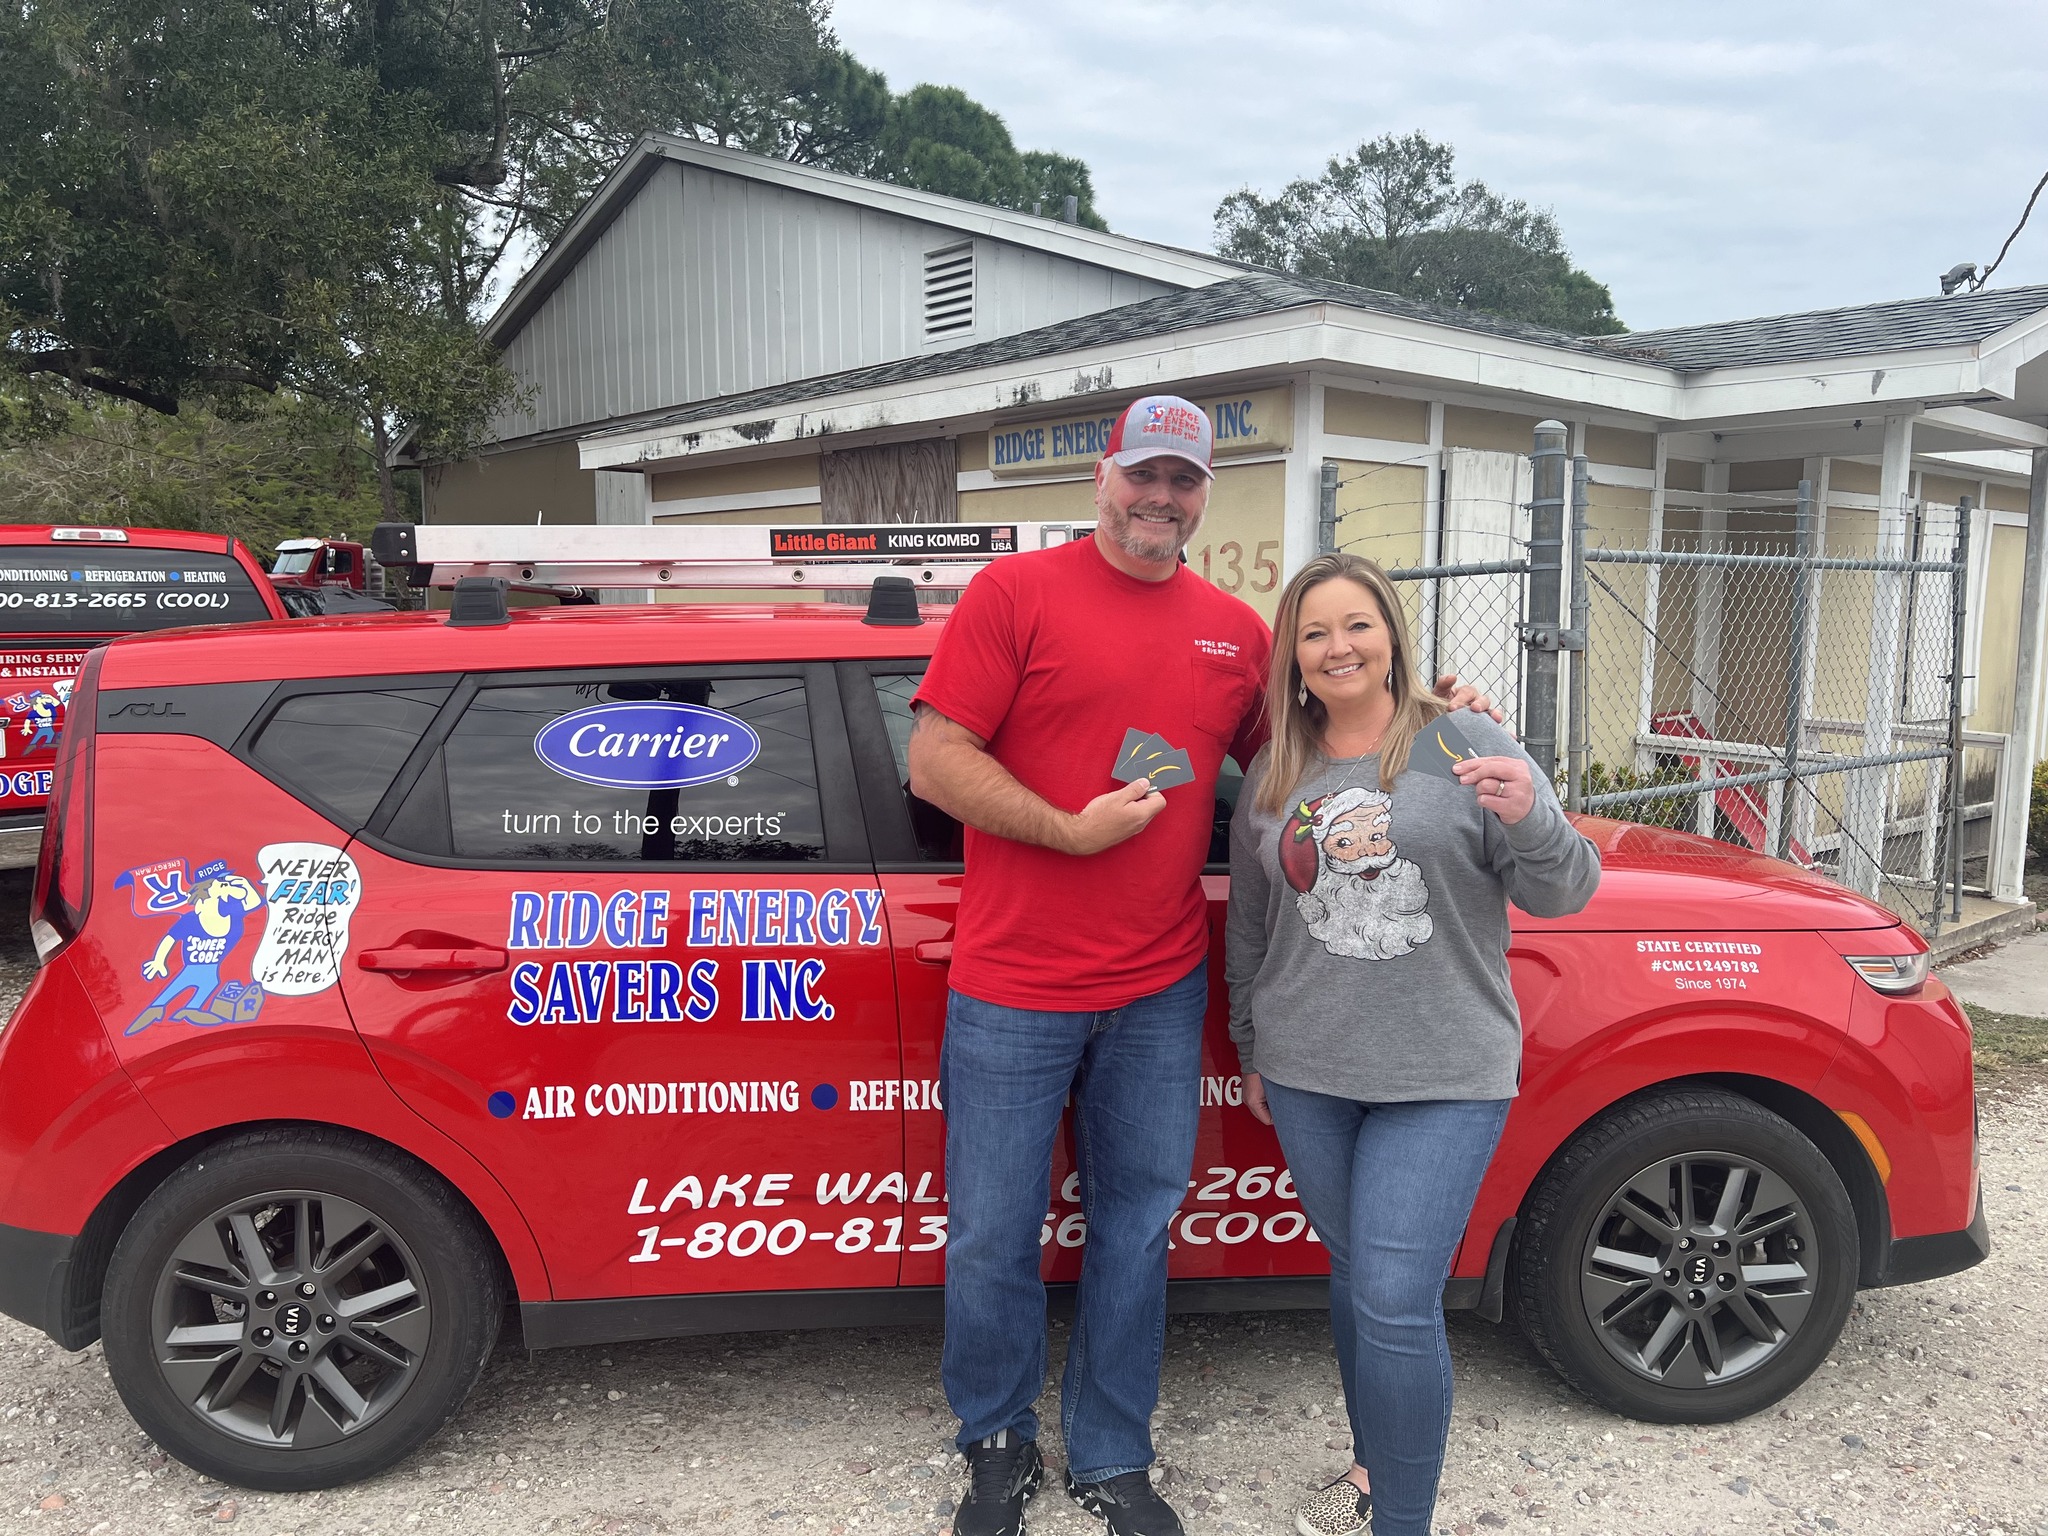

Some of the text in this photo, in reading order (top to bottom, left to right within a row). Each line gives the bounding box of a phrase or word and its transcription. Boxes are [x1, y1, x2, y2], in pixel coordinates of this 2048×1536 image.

[1168, 406, 1199, 425] RIDGE
[994, 400, 1258, 465] RIDGE ENERG INC.
[1142, 423, 1183, 436] SAVERS
[888, 534, 923, 548] KING
[927, 533, 979, 547] KOMBO
[991, 542, 1012, 551] USA
[85, 570, 166, 583] REFRIGERATION
[183, 571, 226, 583] HEATING
[1199, 541, 1279, 594] 135
[156, 592, 230, 610] (COOL)
[46, 653, 84, 663] SERV
[0, 667, 12, 678] &
[108, 702, 186, 718] SOUL
[568, 723, 729, 759] Carrier
[502, 810, 561, 834] turn
[572, 810, 601, 834] to
[613, 810, 659, 835] the
[135, 860, 181, 876] ENERGY MAN
[198, 862, 225, 879] RIDGE
[267, 859, 350, 879] NEVER
[268, 879, 356, 905] FEAR!
[282, 907, 337, 930] Ridge
[507, 888, 885, 950] RIDGE ENERGY
[1636, 940, 1762, 955] STATE CERTIFIED
[261, 966, 278, 982] is
[1651, 960, 1760, 973] #CMC1249782
[507, 958, 836, 1026] SAVERS INC.
[1675, 977, 1747, 990] Since 1974
[522, 1086, 576, 1120] AIR
[585, 1080, 799, 1117] CONDITIONING
[627, 1173, 794, 1216] LAKE
[816, 1171, 949, 1206] WAL
[1694, 1258, 1706, 1282] KIA
[285, 1307, 300, 1334] KIA
